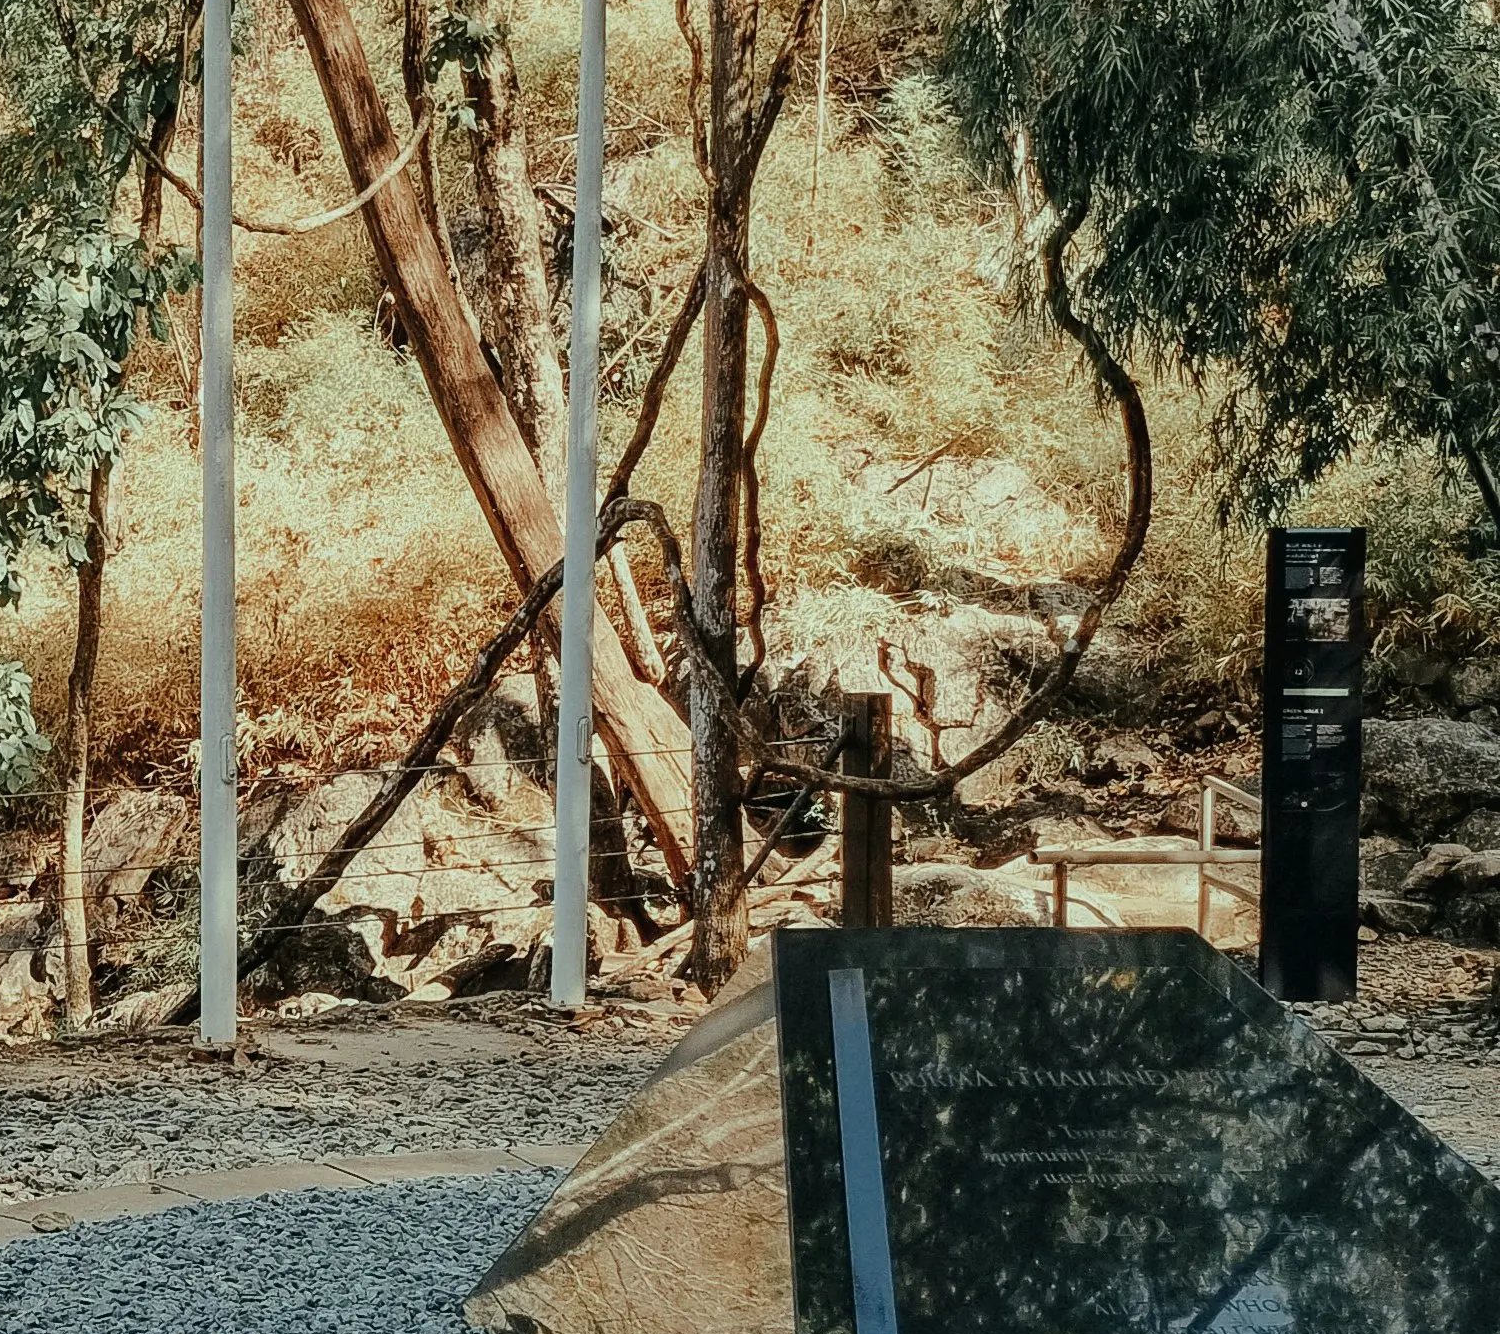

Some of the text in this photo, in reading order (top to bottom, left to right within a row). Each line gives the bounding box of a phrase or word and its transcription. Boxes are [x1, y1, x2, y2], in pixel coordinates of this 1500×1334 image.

[1013, 1069, 1169, 1088] THAILAND
[1057, 1215, 1176, 1245] 1942
[1222, 1298, 1281, 1314] WHO
